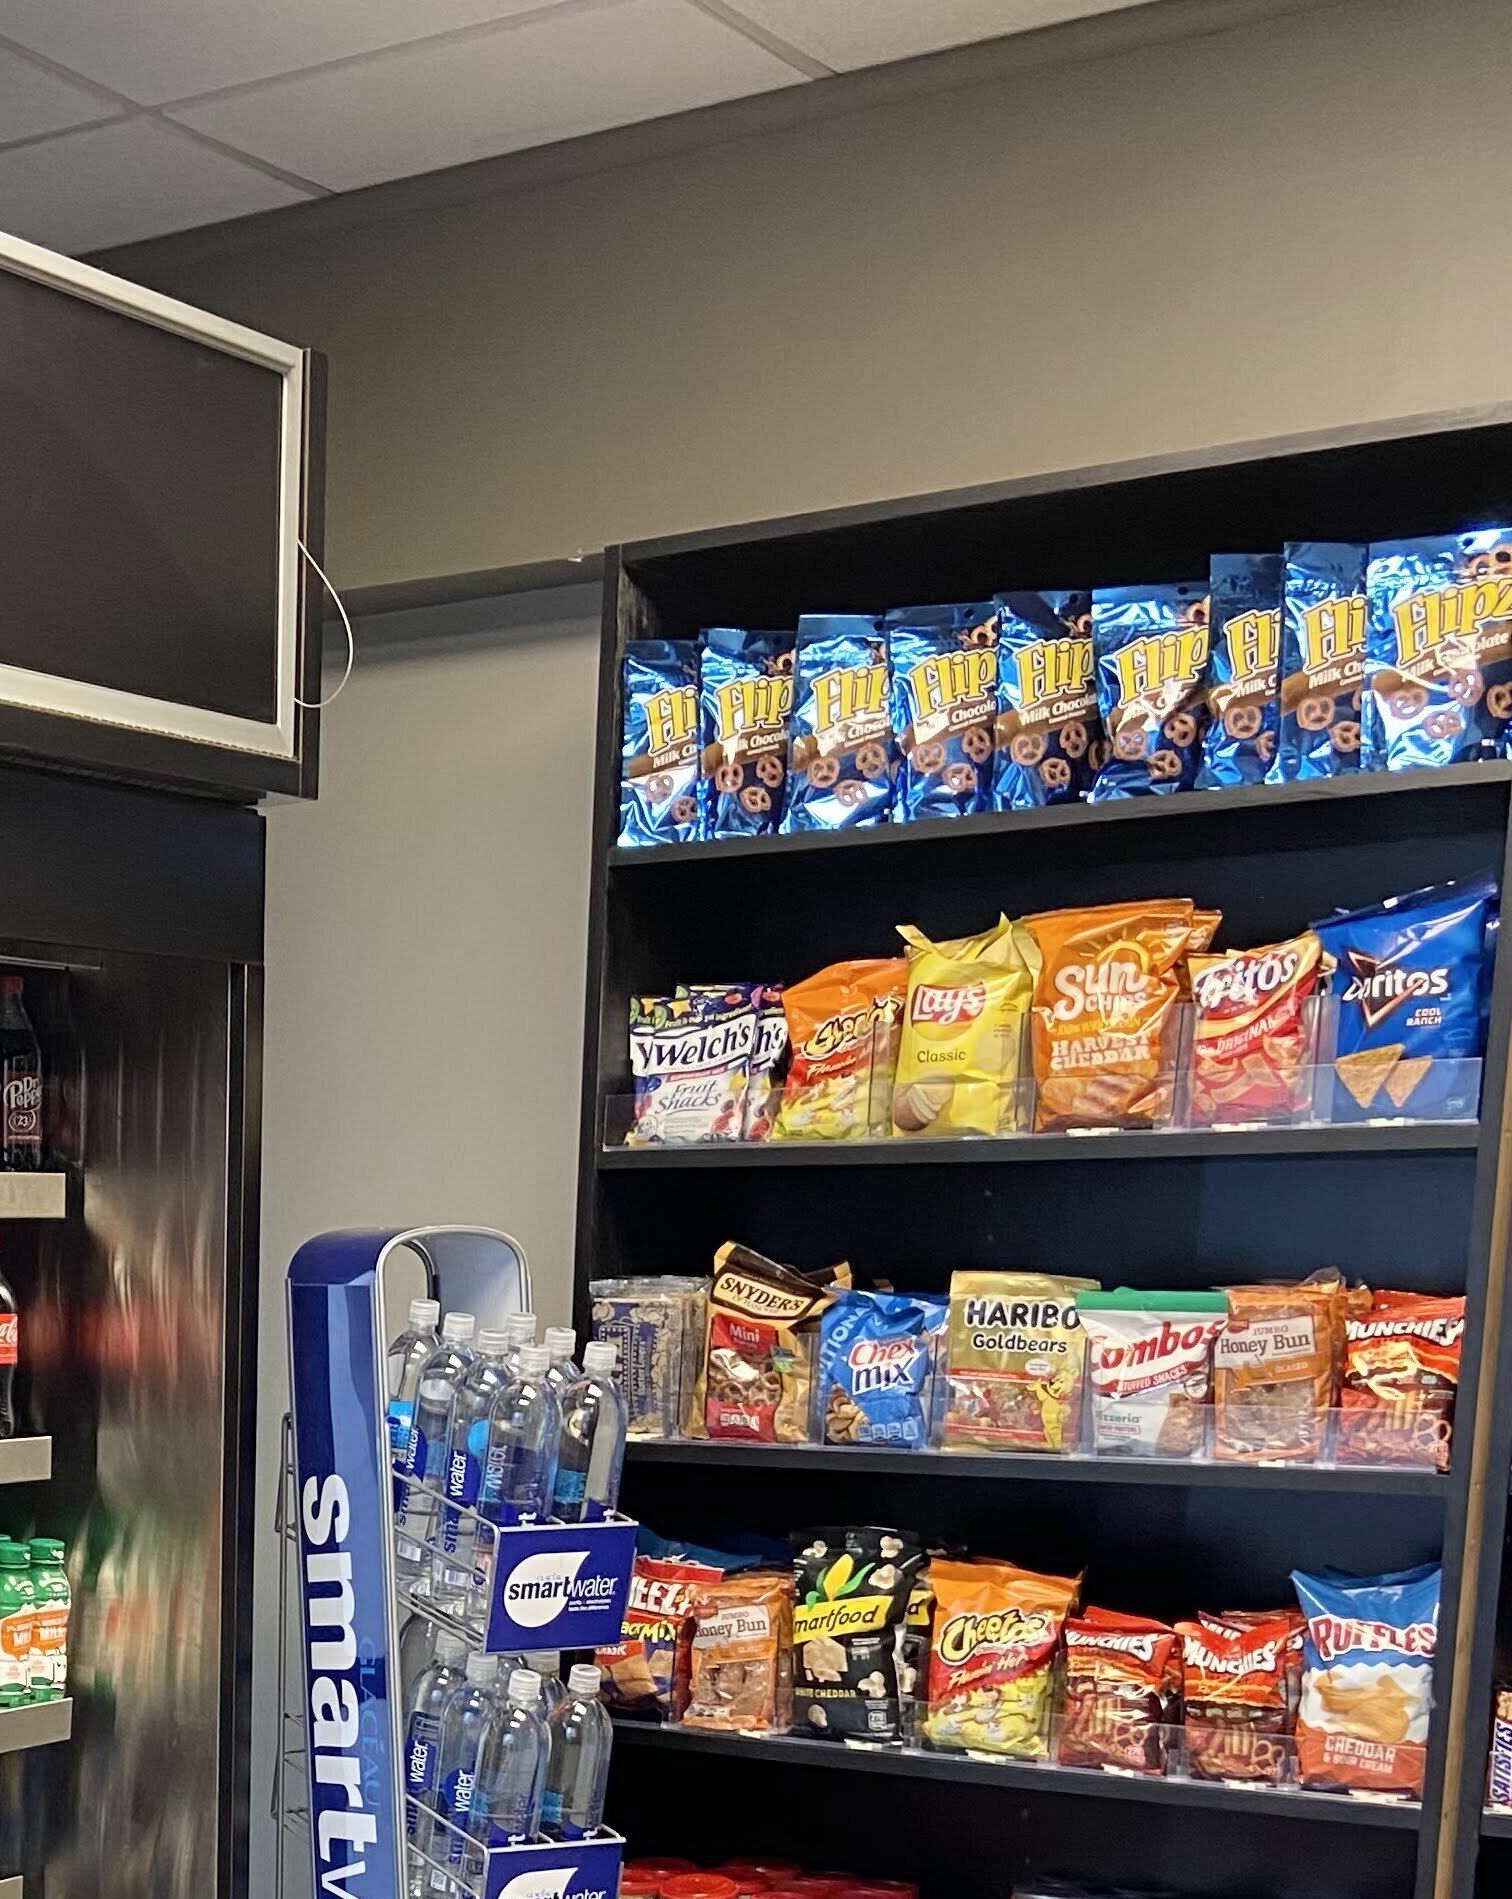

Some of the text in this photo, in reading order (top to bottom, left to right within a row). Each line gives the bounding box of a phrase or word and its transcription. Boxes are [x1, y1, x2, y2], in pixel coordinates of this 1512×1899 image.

[1302, 596, 1367, 674] Fli
[1015, 640, 1093, 708] Flip
[1116, 627, 1209, 705] Flip
[814, 664, 890, 733] Flip
[910, 650, 996, 723] Flip
[643, 687, 696, 754] Fli
[716, 677, 792, 743] Flip
[655, 1023, 751, 1067] Welch's
[917, 1047, 966, 1064] Classic
[656, 1090, 723, 1114] Snacks
[672, 1079, 718, 1097] Fruit
[966, 1300, 1081, 1330] HARIBO
[730, 1322, 760, 1343] Mini
[972, 1333, 1068, 1353] Goldbears
[1100, 1320, 1226, 1370] ombos
[1220, 1332, 1311, 1357] Honey Bun
[851, 1339, 915, 1366] Chex
[1118, 1378, 1152, 1393] TUFFED
[450, 1451, 467, 1497] water
[508, 1575, 619, 1600] smartwater
[737, 1618, 767, 1634] Bun
[795, 1604, 880, 1633] martfood
[410, 1741, 428, 1783] water
[1325, 1735, 1397, 1764] CHEDDAR
[455, 1769, 474, 1812] water
